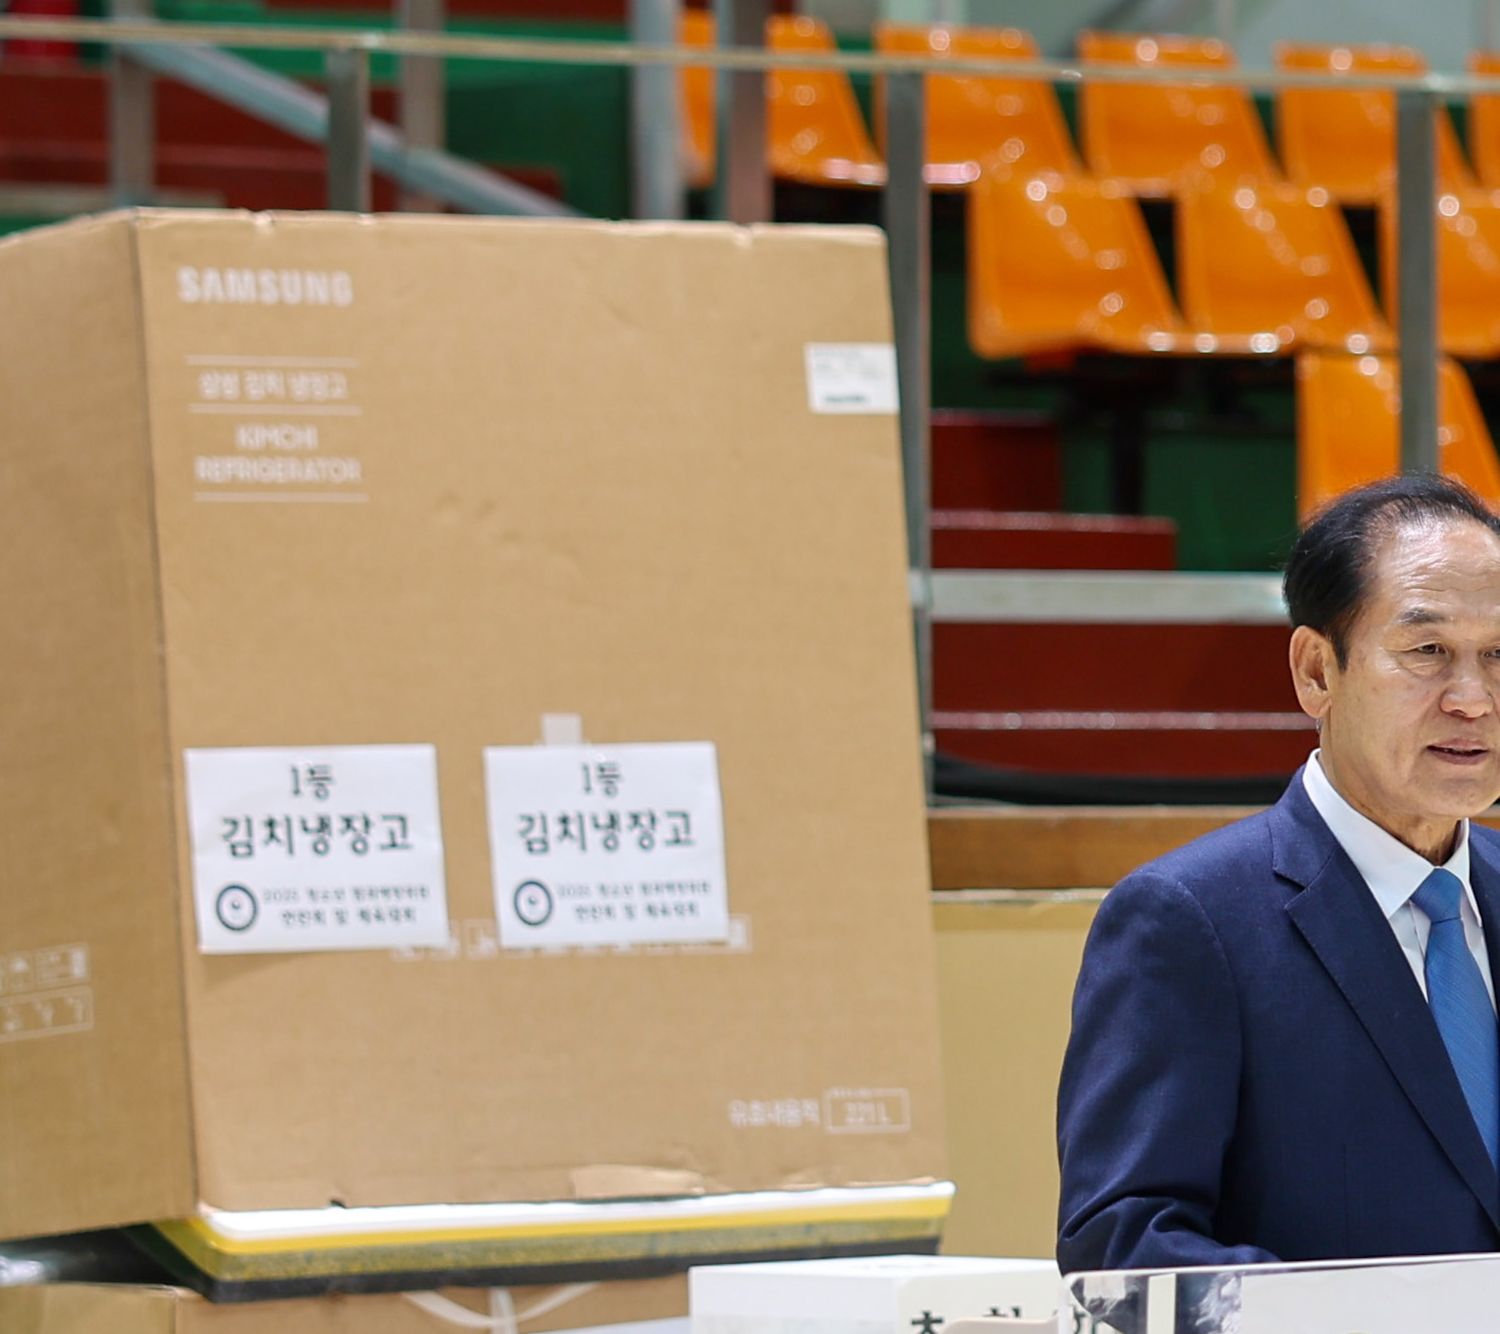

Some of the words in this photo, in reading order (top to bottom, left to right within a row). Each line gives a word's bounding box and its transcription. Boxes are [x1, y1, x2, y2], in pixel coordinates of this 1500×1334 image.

[177, 266, 355, 307] SAMSUNG
[236, 424, 319, 451] KIMCHI
[194, 455, 363, 484] REFRIGERATOR
[290, 765, 334, 801] 1등
[581, 763, 622, 797] 1등
[221, 812, 414, 859] 김치냉장고
[518, 809, 696, 854] 김치냉장고
